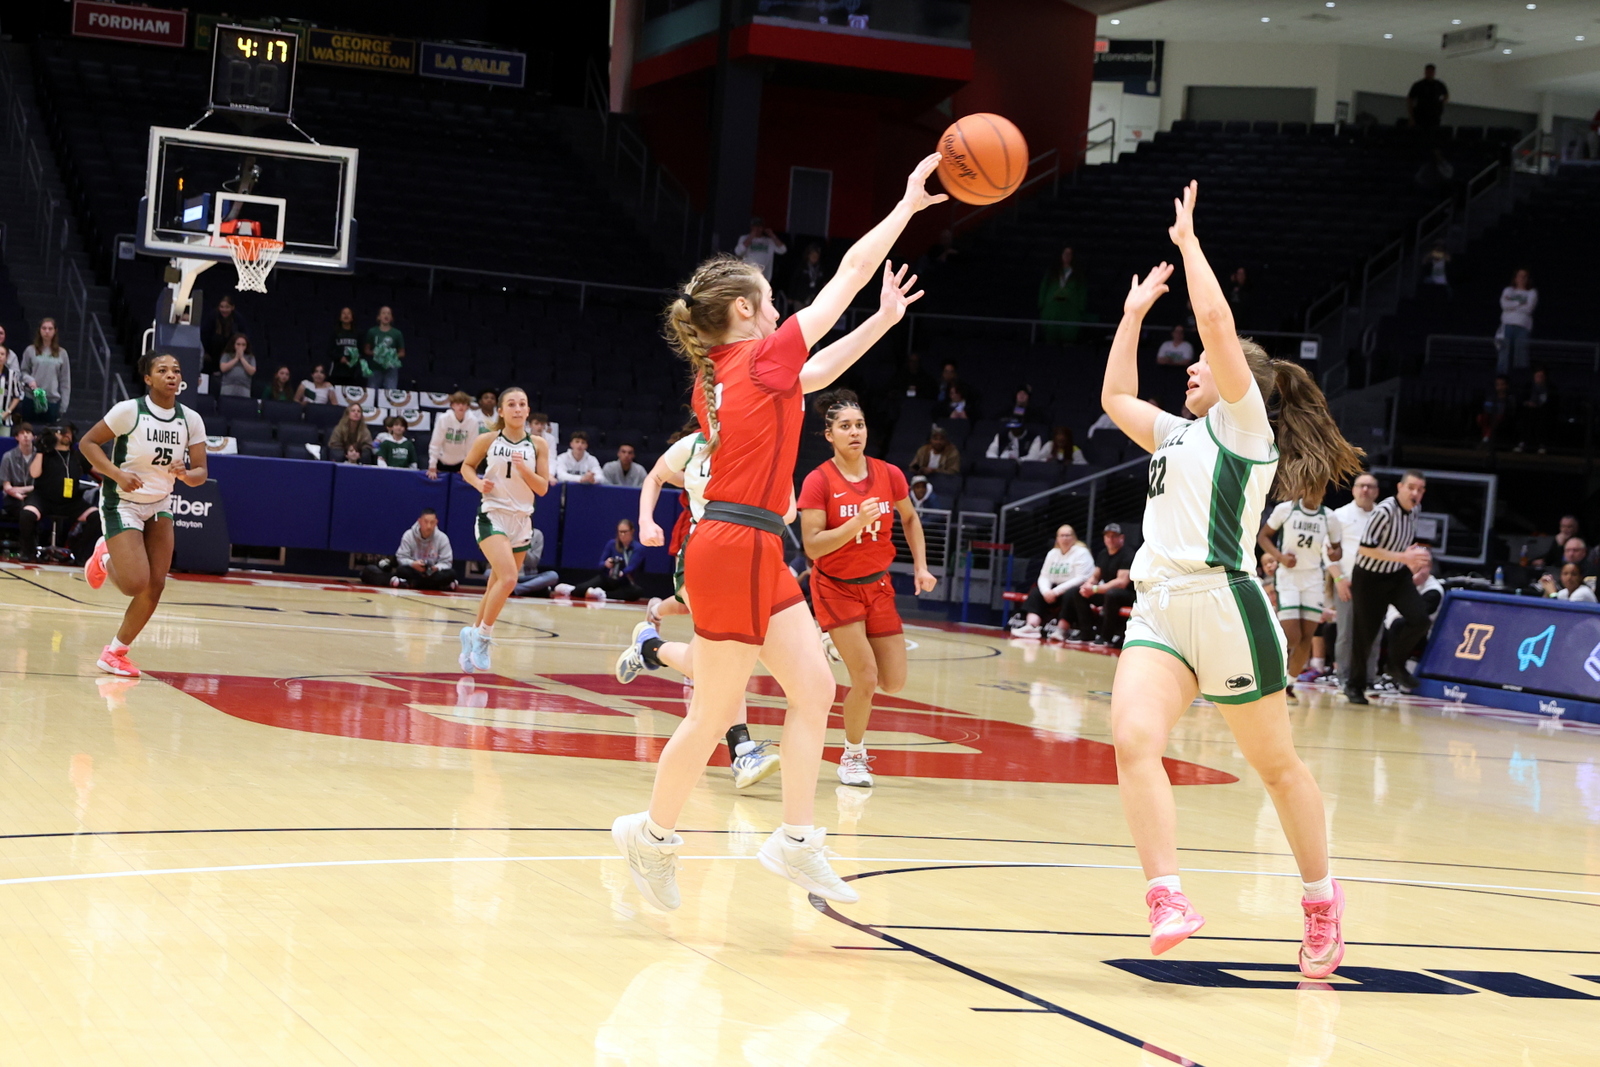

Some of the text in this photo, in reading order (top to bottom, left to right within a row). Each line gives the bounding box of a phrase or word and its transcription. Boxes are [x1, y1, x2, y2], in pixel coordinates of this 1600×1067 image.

[88, 12, 171, 35] FORDHAM
[237, 37, 288, 63] 4:17
[331, 35, 392, 54] GEORGE
[312, 47, 411, 69] WASHINGTON
[434, 53, 510, 76] LA SALLE
[146, 427, 181, 445] LAUREL
[151, 446, 173, 466] 25
[493, 445, 529, 461] LAUL
[505, 460, 512, 479] 1
[1148, 455, 1167, 499] 22
[839, 501, 891, 518] BELUE
[175, 519, 204, 529] dayton
[1293, 519, 1321, 534] LAUREL
[1297, 533, 1314, 549] 24
